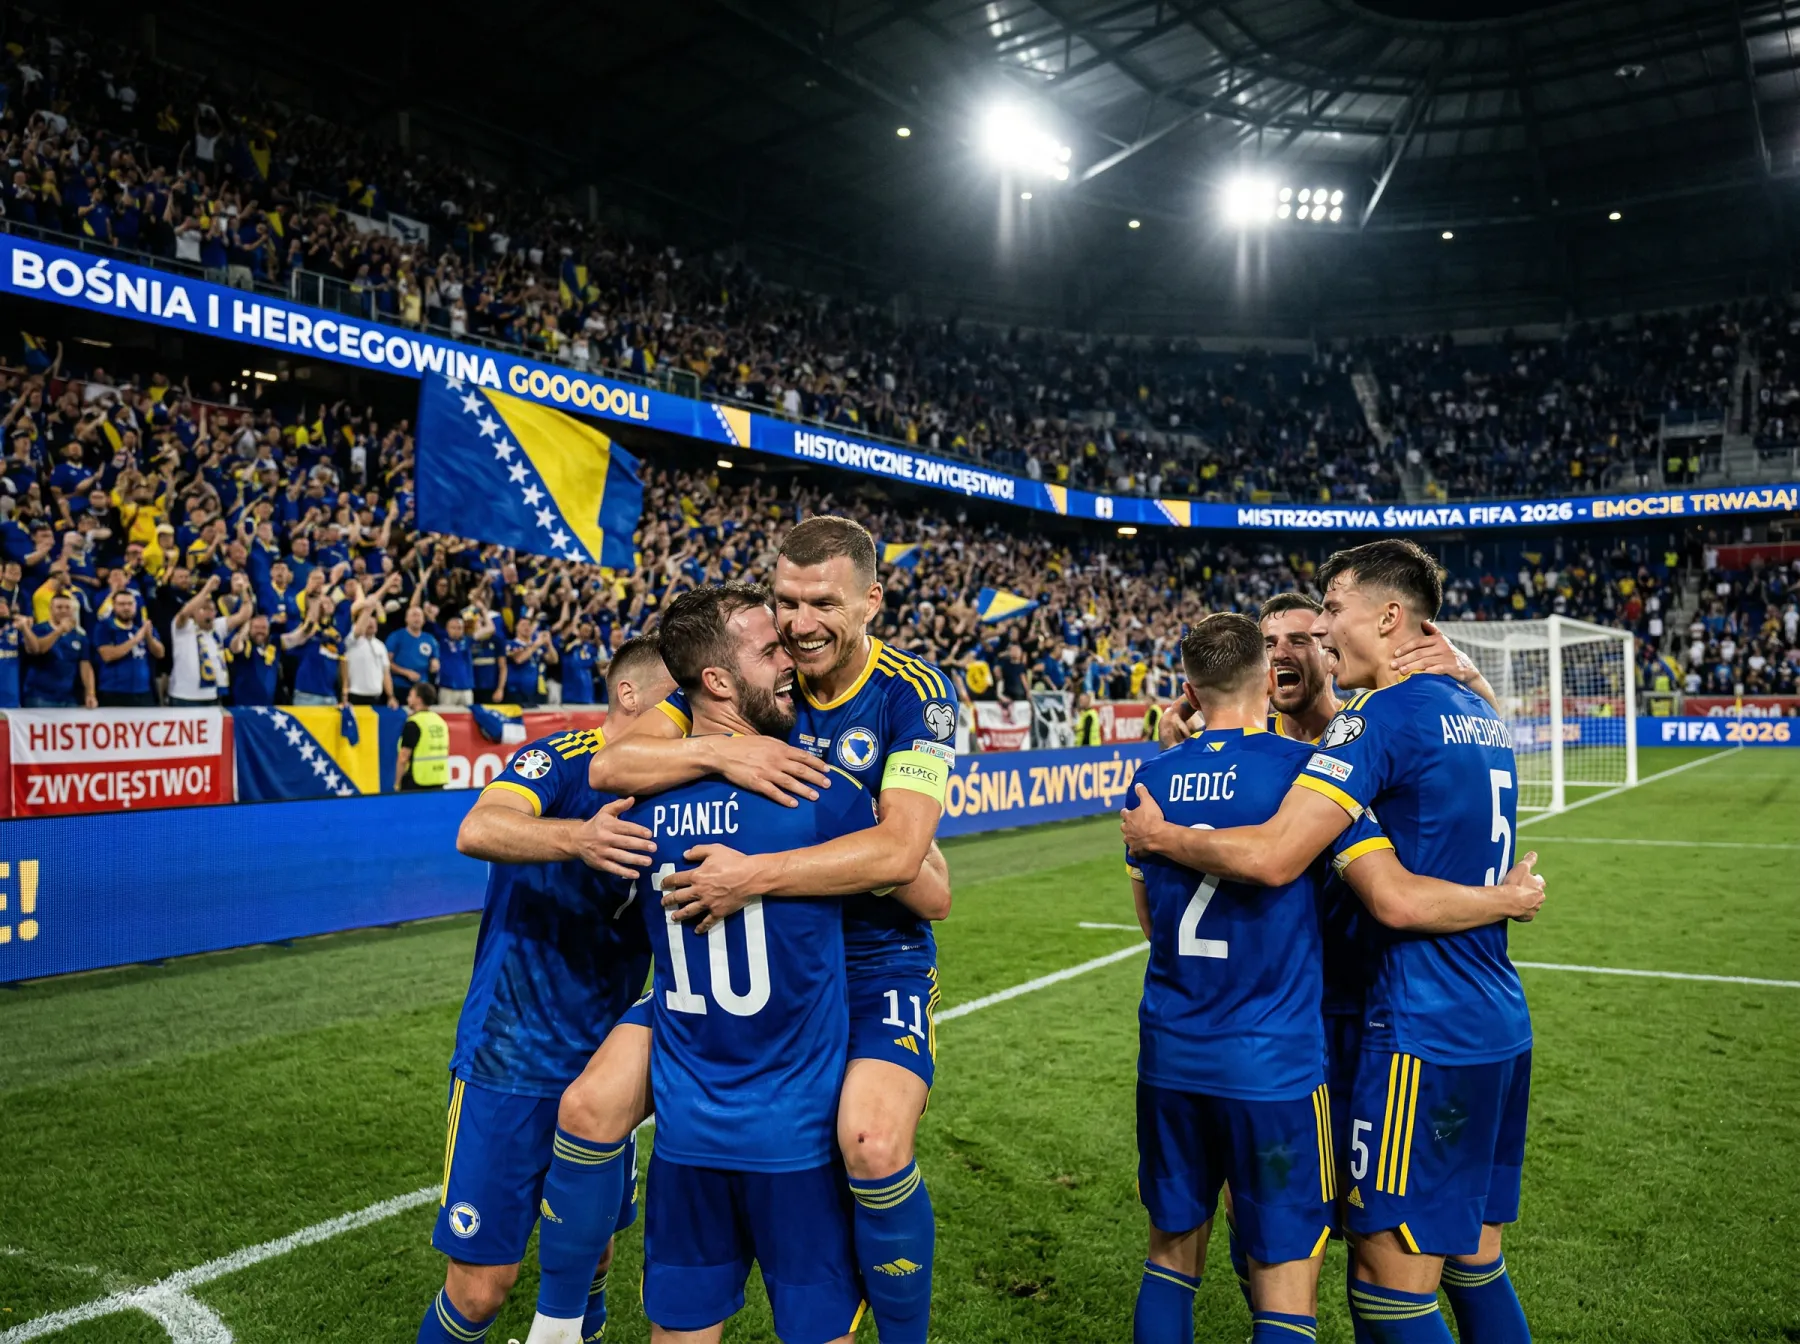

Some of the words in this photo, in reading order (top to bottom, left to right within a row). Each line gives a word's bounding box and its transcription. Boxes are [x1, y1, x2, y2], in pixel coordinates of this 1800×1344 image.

[12, 249, 197, 323] BOŚNIA
[209, 295, 219, 328] I
[233, 299, 502, 391] HERCEGOWINA
[508, 364, 650, 421] GOOOOOL!
[794, 430, 913, 478] HISTORYCZNE
[914, 458, 1015, 500] ZWYCIĘSTWO!
[1237, 508, 1381, 528] MISTRZOSTWA
[1383, 505, 1465, 528] ŚWIATA
[1469, 507, 1517, 525] FIFA
[1520, 503, 1573, 523] 2026
[1592, 496, 1685, 519] EMOCJE
[1689, 488, 1798, 512] TRWAJĄ!
[29, 719, 208, 752] HISTORYCZNE
[1661, 722, 1721, 742] FIFA
[1725, 722, 1791, 742] 2026
[26, 765, 212, 808] ZWYCIĘSTWO!
[941, 761, 1025, 818] OŚNIA
[1029, 750, 1142, 808] ZWYCIĘŻA
[1168, 764, 1237, 802] DEDIĆ
[653, 791, 739, 838] PJANIĆ
[1484, 768, 1513, 887] 5
[1178, 822, 1229, 959] 2
[651, 862, 771, 1016] 10
[882, 989, 926, 1040] 11
[1350, 1118, 1373, 1180] 5
